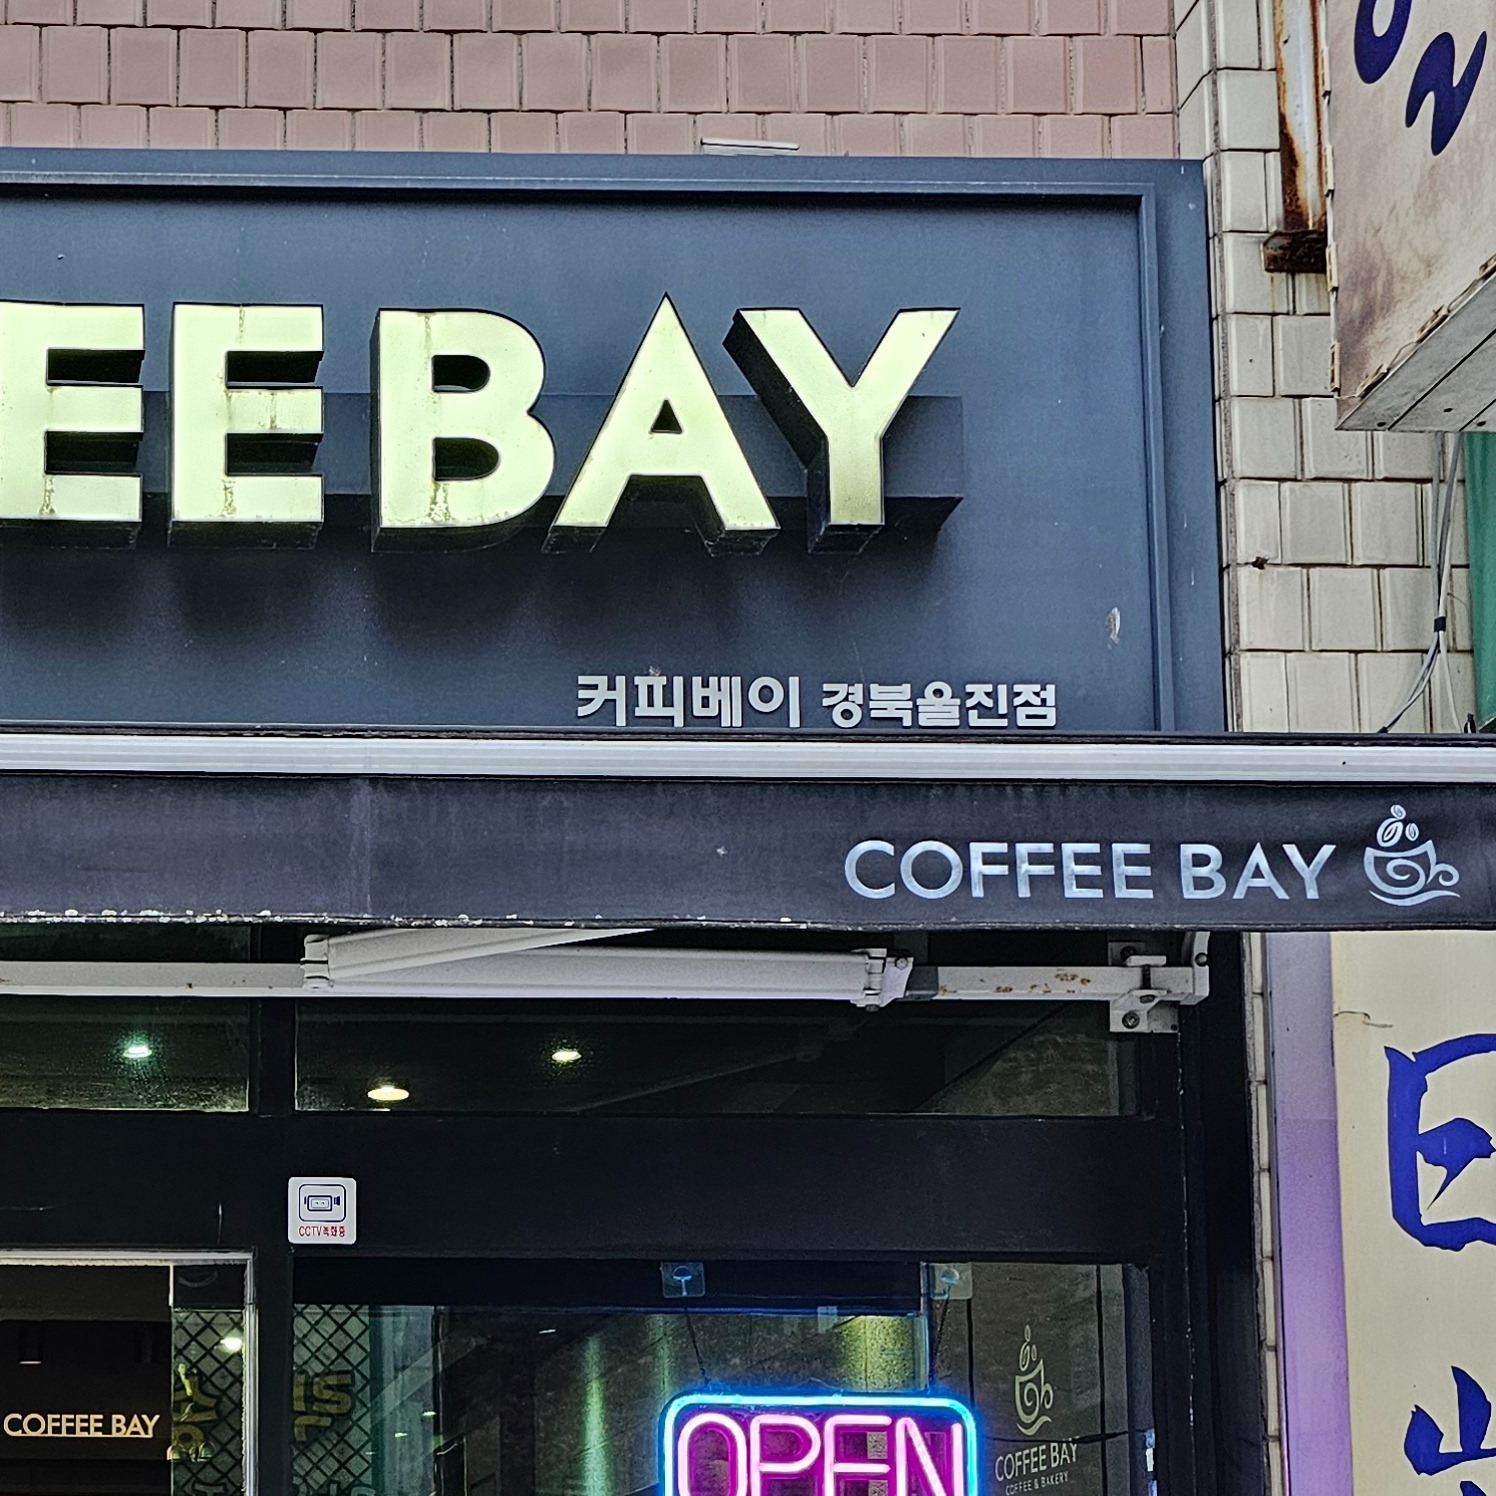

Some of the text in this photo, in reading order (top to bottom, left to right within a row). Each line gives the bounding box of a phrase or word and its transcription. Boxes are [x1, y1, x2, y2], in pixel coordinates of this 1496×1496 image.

[378, 295, 956, 532] BAY
[576, 675, 1058, 729] 커피베이 경북울진점
[844, 840, 1337, 901] COFFEE BAY
[4, 1413, 160, 1437] COFFEE BAY
[995, 1437, 1079, 1481] COFFEE BAY
[1005, 1477, 1033, 1496] COFFEE
[1040, 1471, 1069, 1487] BAKERY
